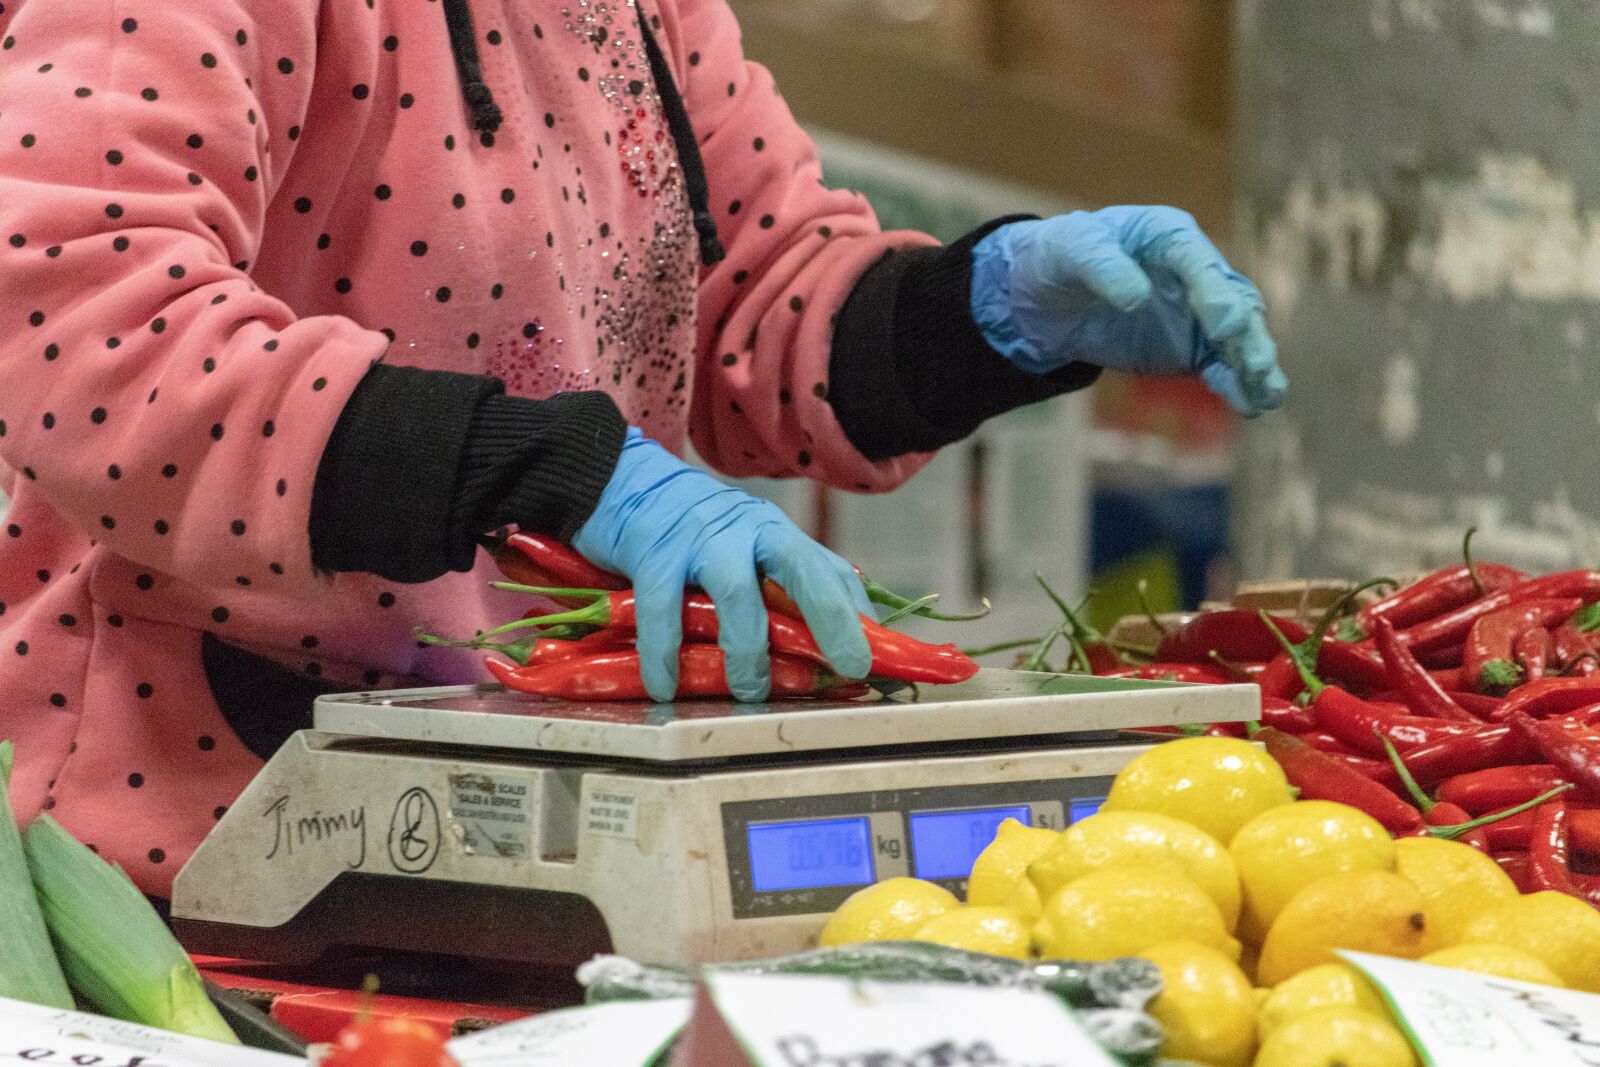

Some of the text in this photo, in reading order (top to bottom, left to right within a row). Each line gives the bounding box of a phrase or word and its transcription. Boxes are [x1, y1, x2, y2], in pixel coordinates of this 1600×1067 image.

[498, 783, 527, 796] SCALES
[459, 793, 482, 805] SALES
[491, 796, 522, 808] SERVICE
[263, 795, 366, 869] Jimmy
[877, 835, 900, 859] kg
